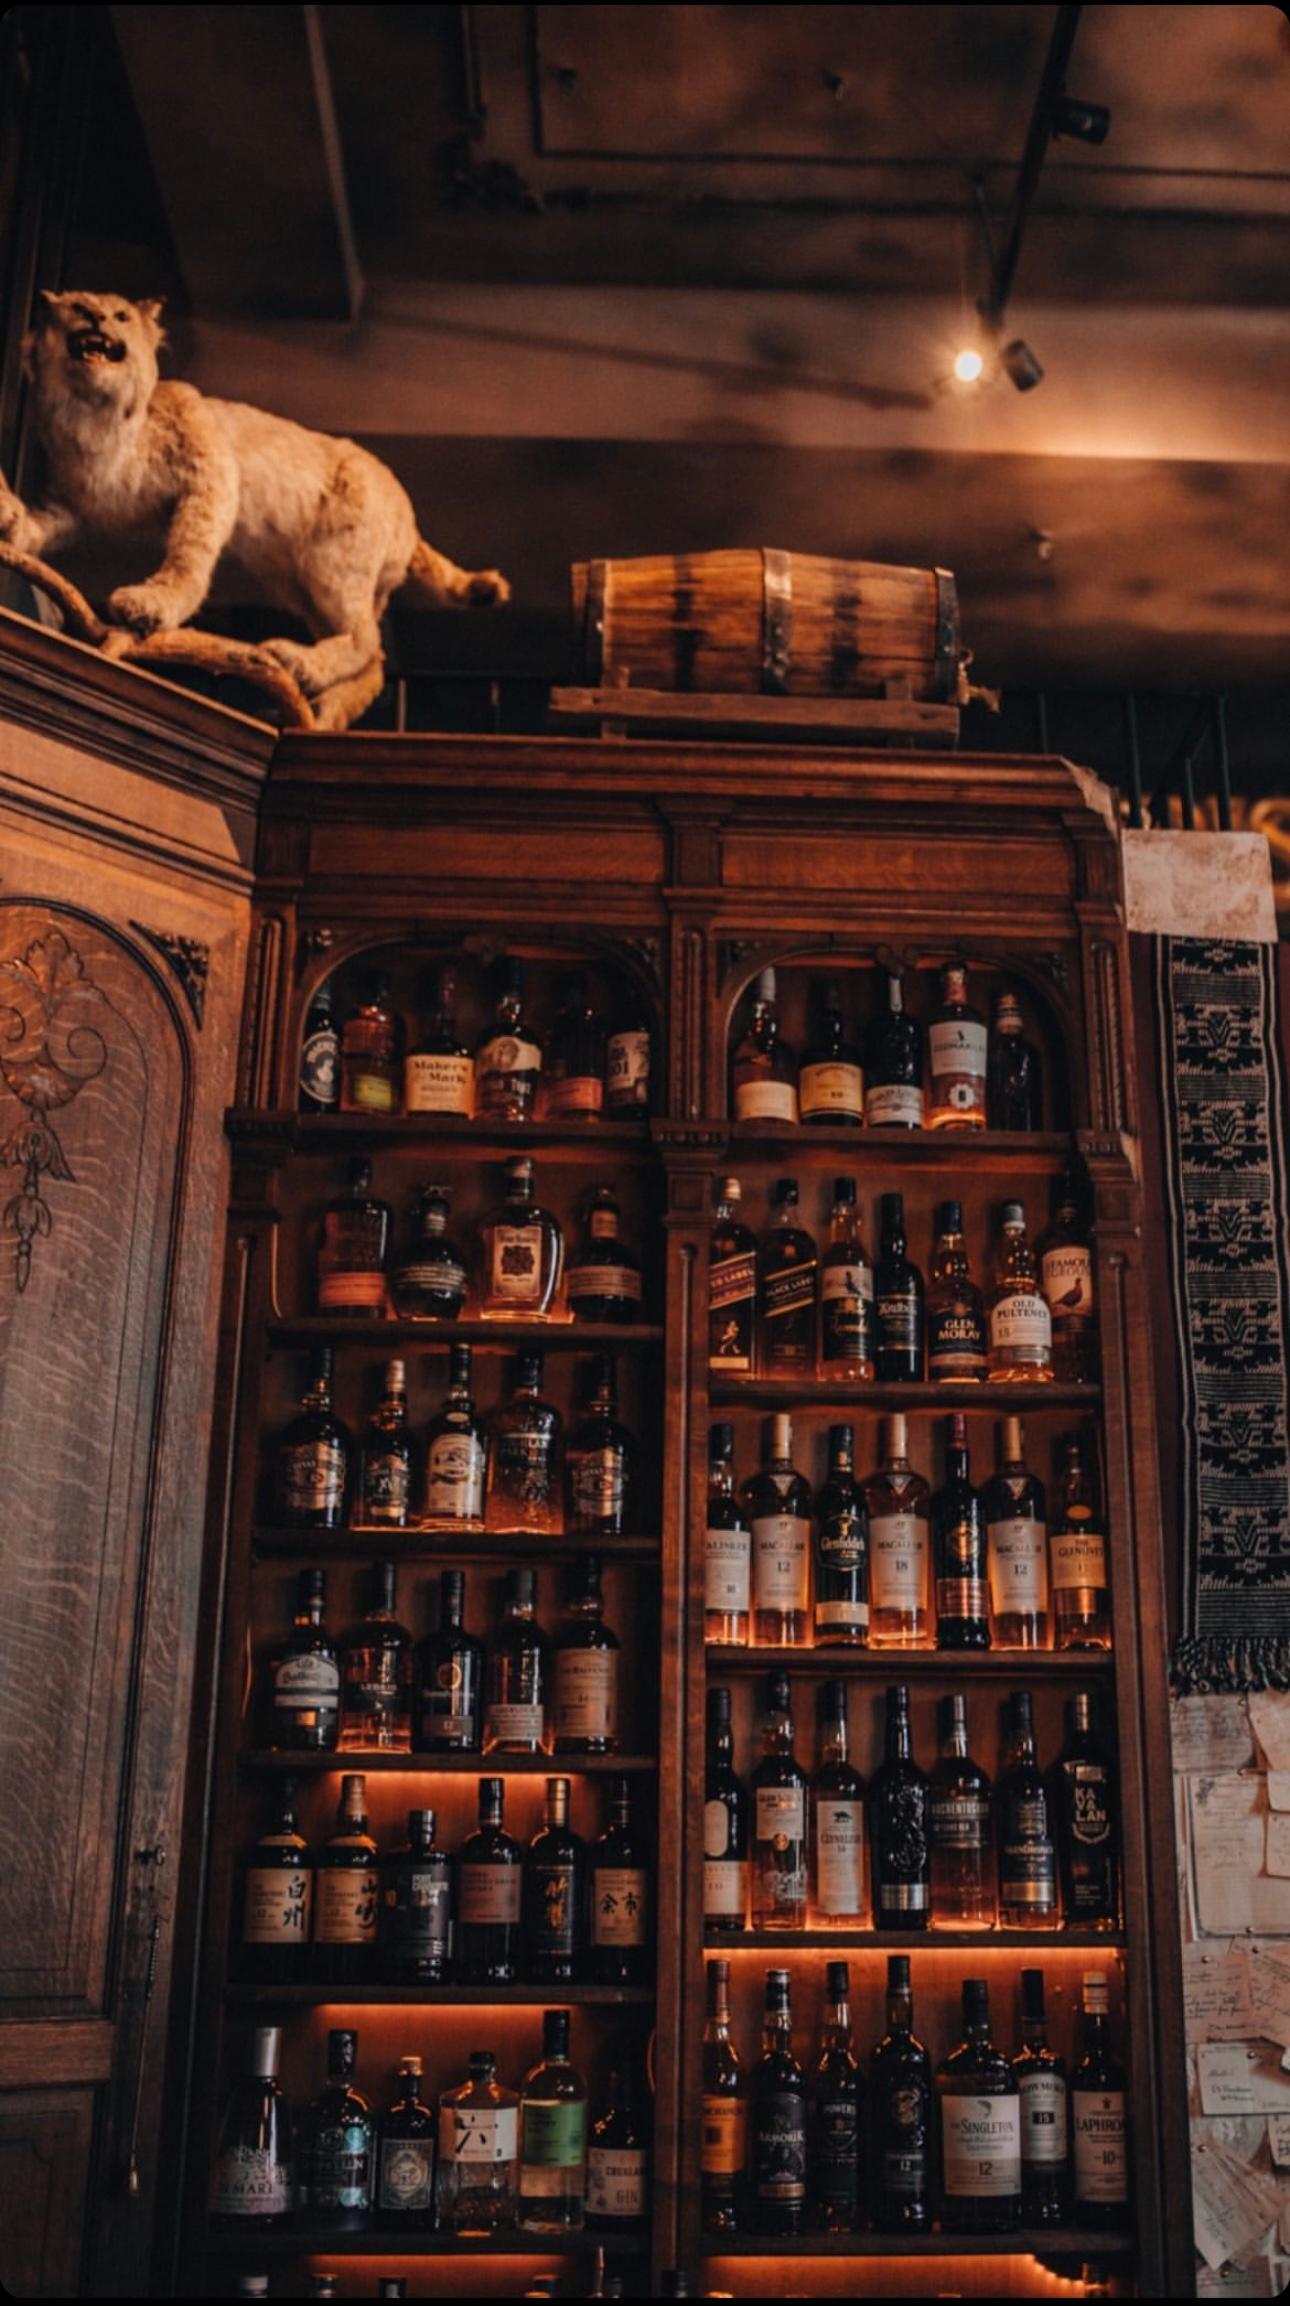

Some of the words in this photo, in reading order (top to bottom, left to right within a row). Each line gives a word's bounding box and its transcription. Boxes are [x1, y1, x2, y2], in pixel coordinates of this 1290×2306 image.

[414, 1060, 468, 1074] Maker's
[1012, 1299, 1036, 1308] OLD
[944, 1318, 976, 1329] GLEN
[937, 1328, 982, 1341] MORAY
[777, 1561, 791, 1573] 12
[895, 1560, 908, 1572] 18
[1014, 1564, 1028, 1576] 12
[1075, 1787, 1096, 1799] KA
[1075, 1798, 1097, 1810] VA
[1075, 1809, 1107, 1822] LAN
[283, 1875, 307, 1931] 白州
[1102, 2152, 1115, 2166] 10
[978, 2162, 992, 2176] 12
[616, 2190, 638, 2204] GIN
